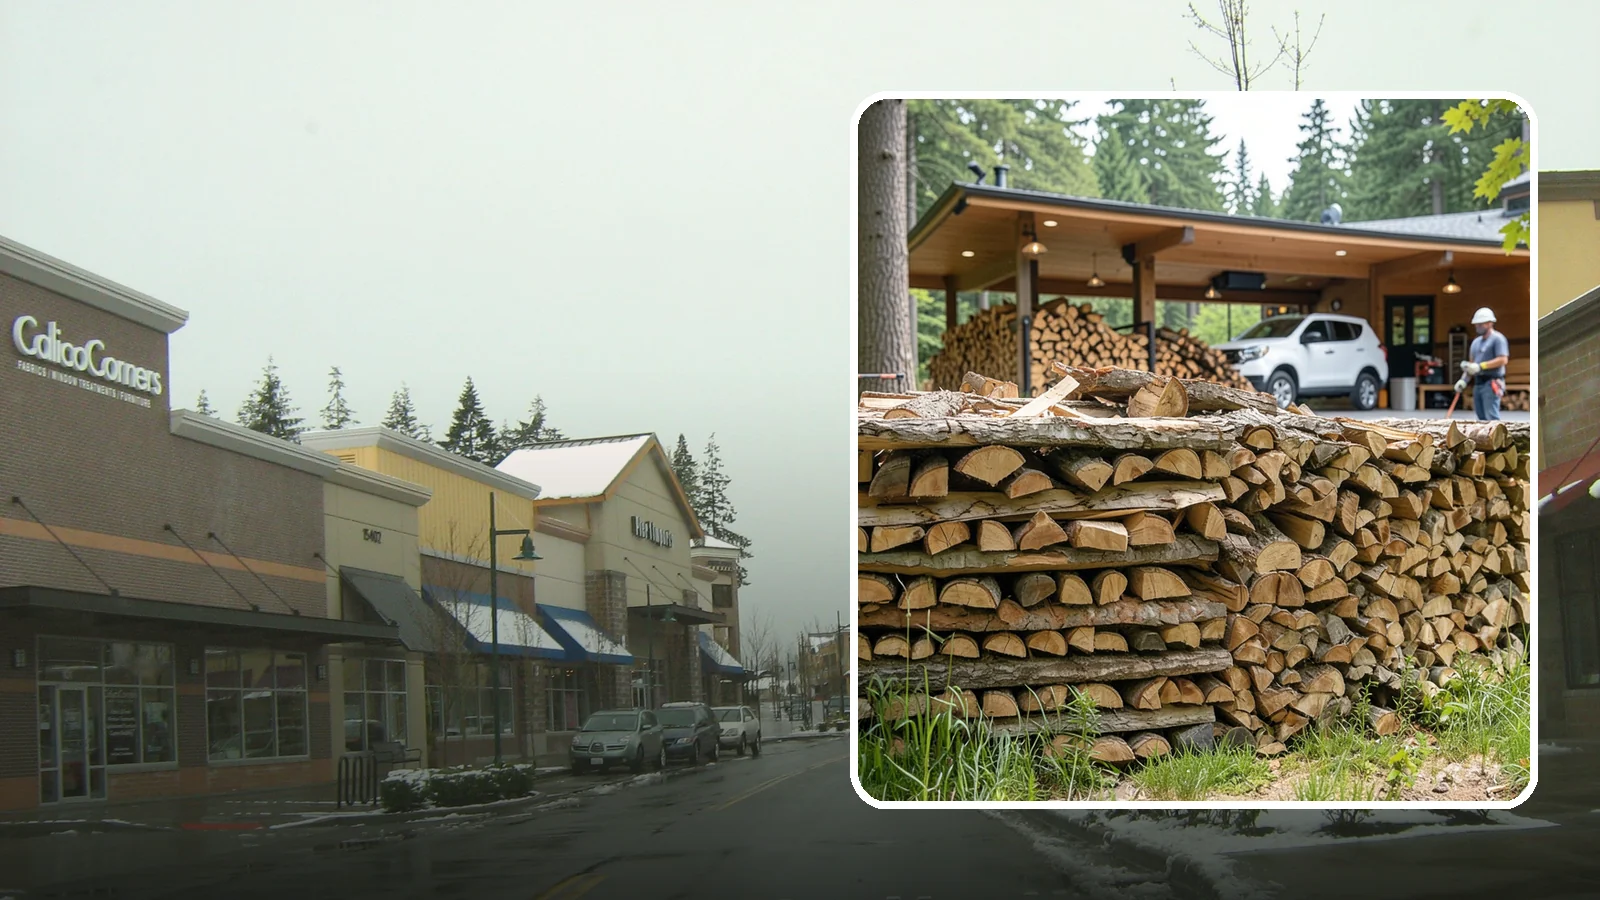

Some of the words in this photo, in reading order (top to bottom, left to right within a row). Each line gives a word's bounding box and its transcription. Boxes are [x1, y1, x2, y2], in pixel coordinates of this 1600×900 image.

[17, 359, 47, 377] FABRICS
[51, 370, 78, 387] WINDOW
[78, 378, 117, 398] TREATMENTS
[119, 389, 151, 409] FURNITURE
